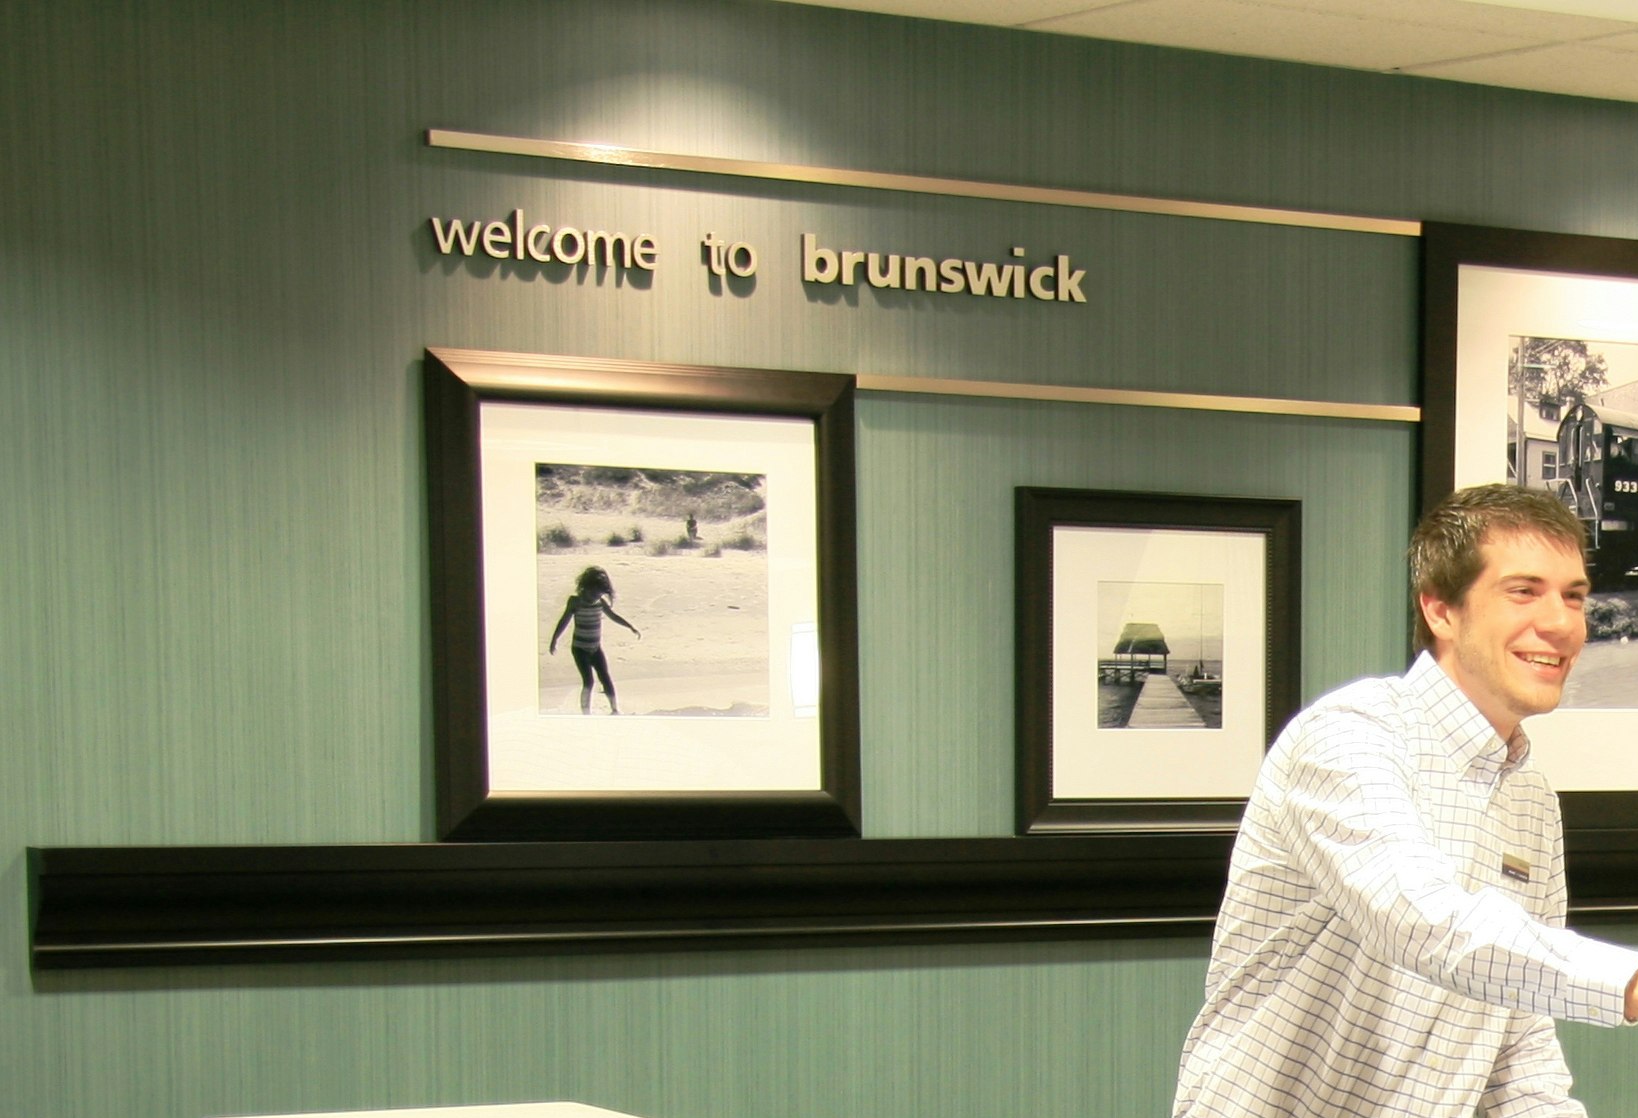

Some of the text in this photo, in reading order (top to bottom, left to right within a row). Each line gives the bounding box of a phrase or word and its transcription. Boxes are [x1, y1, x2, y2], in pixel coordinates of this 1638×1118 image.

[431, 208, 1087, 303] welcome to brunswick
